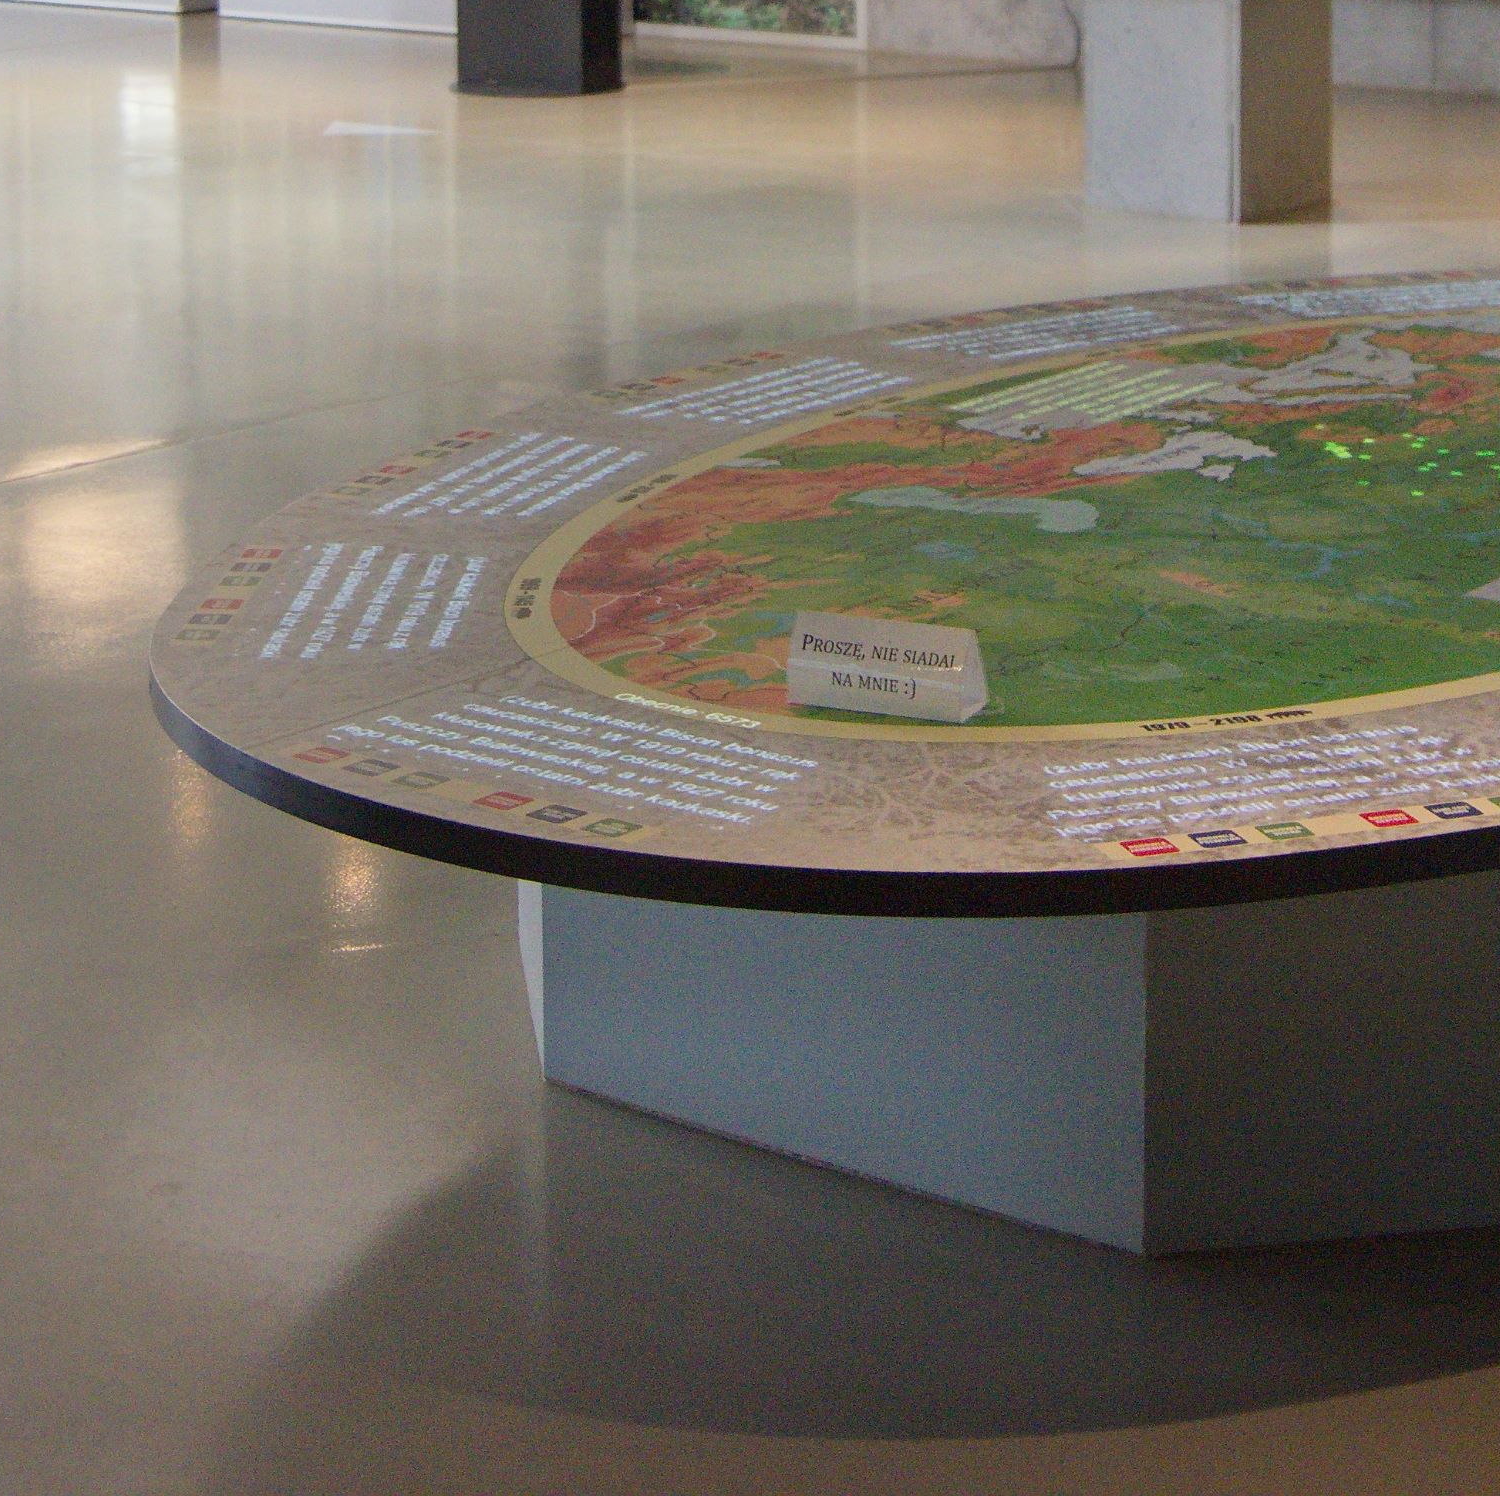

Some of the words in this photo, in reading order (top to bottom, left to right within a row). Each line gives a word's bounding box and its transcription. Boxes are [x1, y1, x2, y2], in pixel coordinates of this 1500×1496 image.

[802, 633, 866, 661] PROSZĘ,
[871, 644, 899, 662] NIE
[831, 671, 853, 687] NA
[858, 675, 899, 694] MNIE
[705, 712, 761, 729] 6573
[656, 729, 721, 746] Bison
[600, 732, 631, 741] W
[633, 739, 686, 754] 1919
[685, 753, 739, 766] roku
[738, 763, 759, 772] z
[512, 765, 588, 785] ostatni
[618, 755, 698, 774] ostatni
[755, 784, 778, 792] w
[639, 776, 662, 784] w
[668, 782, 725, 796] 1927
[724, 795, 778, 810] roku
